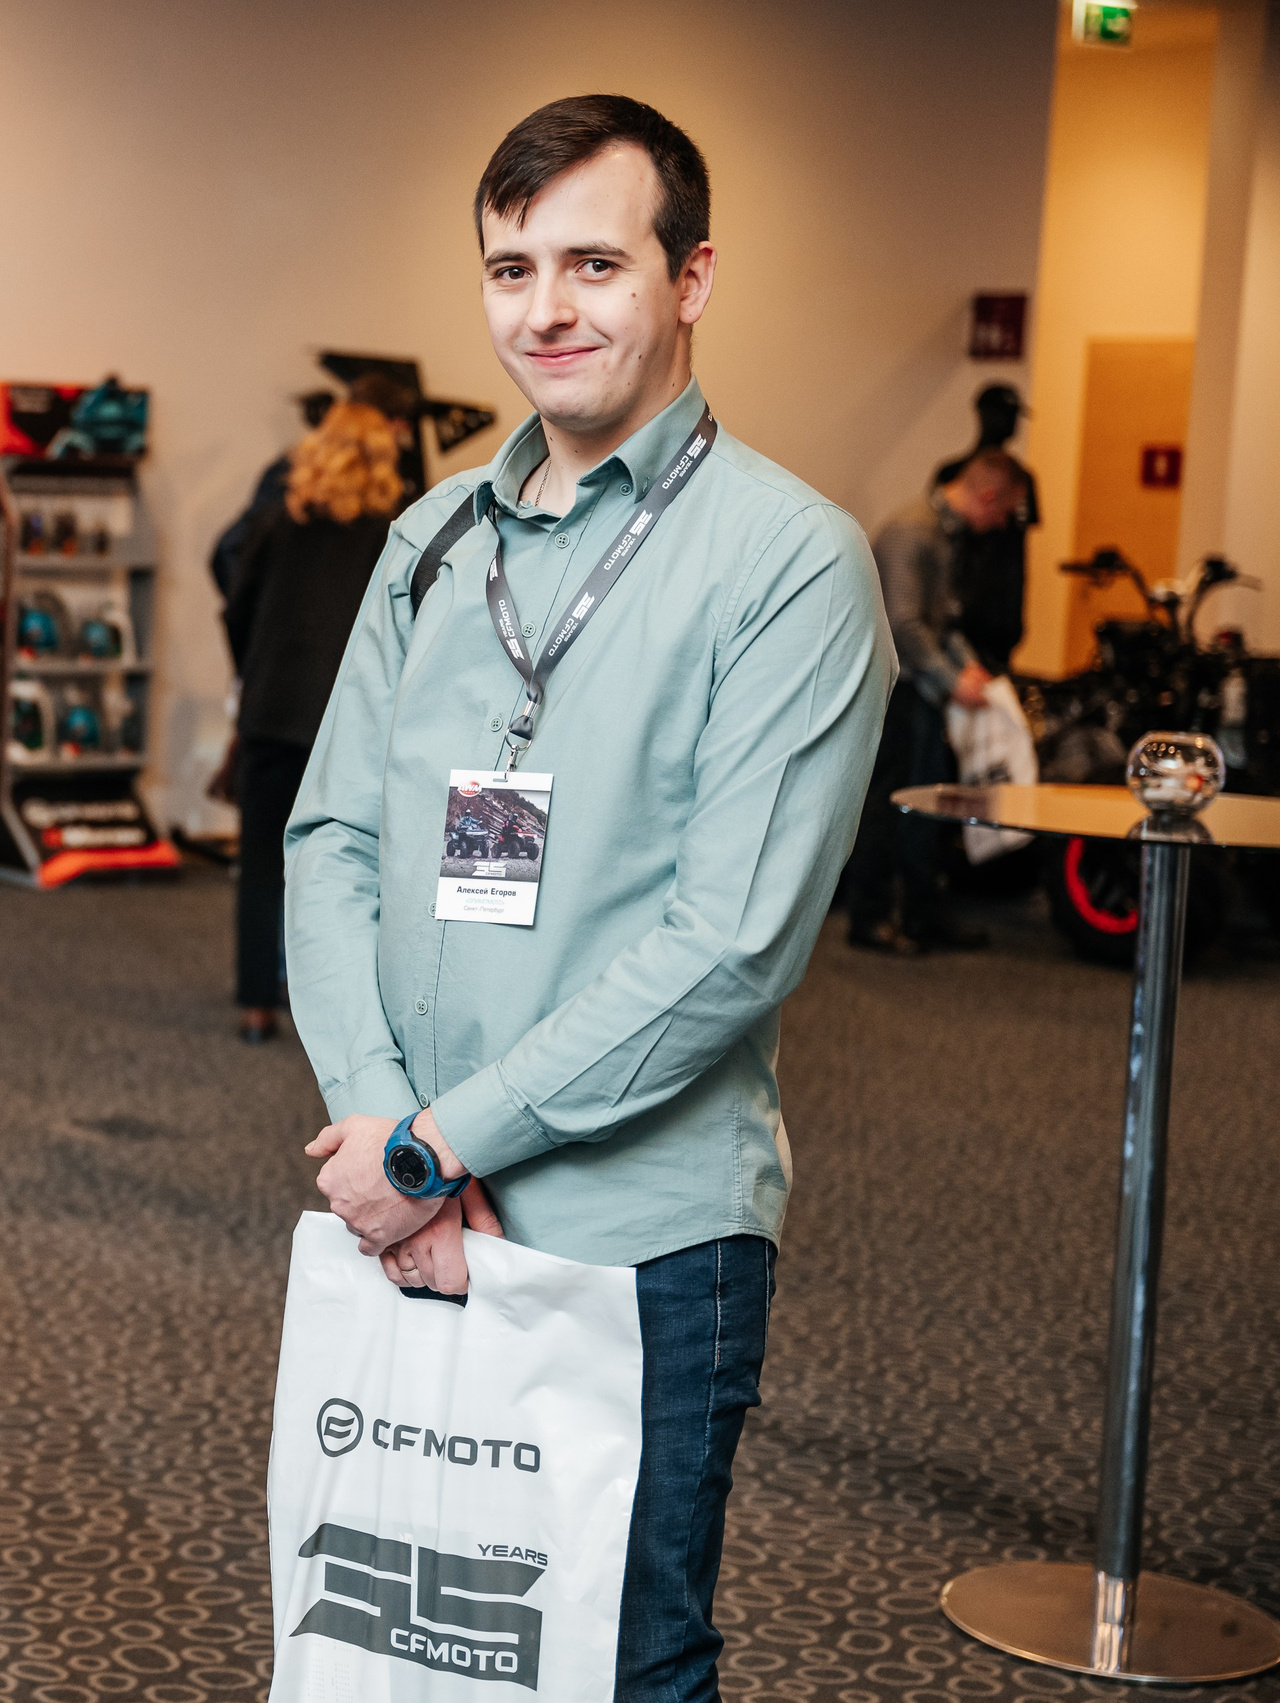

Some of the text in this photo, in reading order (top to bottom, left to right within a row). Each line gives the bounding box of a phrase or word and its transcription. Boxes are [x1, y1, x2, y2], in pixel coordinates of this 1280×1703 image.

[661, 455, 689, 489] CFMOTO
[603, 534, 631, 571] CFMOTO
[498, 599, 515, 637] CFMOTO
[548, 618, 575, 657] CFMOTO
[456, 885, 517, 897] Алексей Егоров
[372, 1418, 541, 1473] CFMOTO
[477, 1543, 548, 1566] YEARS
[390, 1627, 519, 1674] CFMOTO
